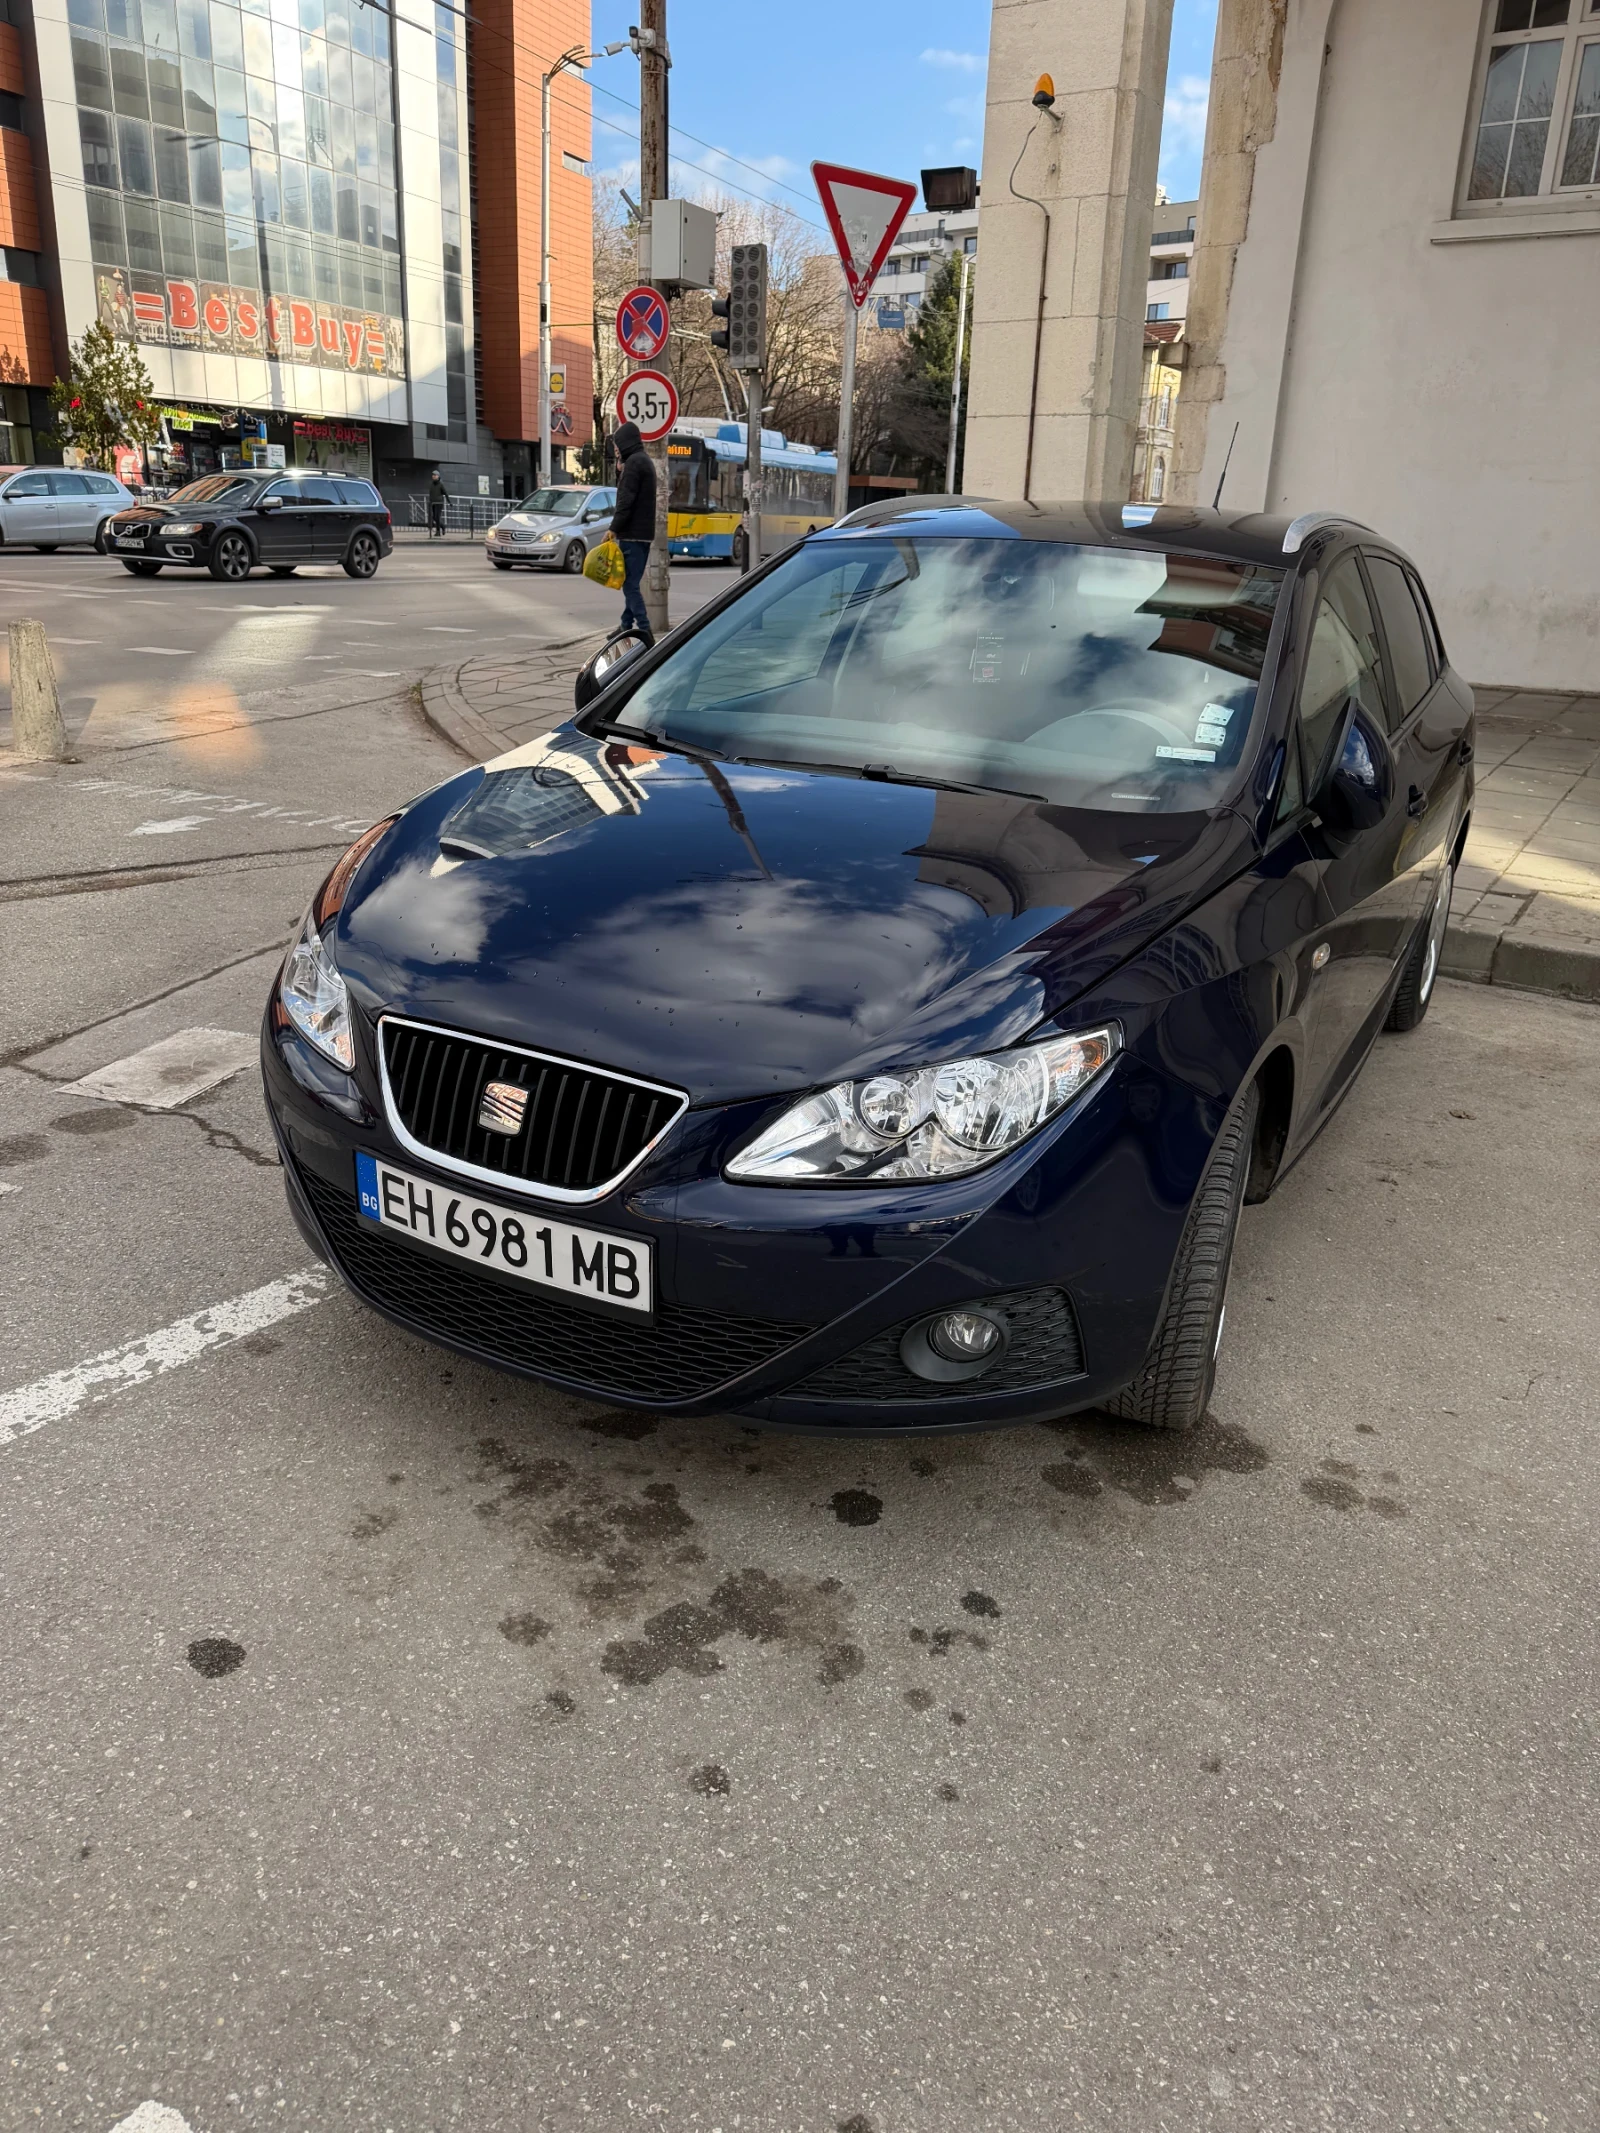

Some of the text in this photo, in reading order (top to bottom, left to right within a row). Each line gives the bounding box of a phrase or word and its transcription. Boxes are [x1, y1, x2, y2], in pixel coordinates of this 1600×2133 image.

[167, 281, 362, 368] Best Buy
[361, 1192, 378, 1211] BG
[381, 1170, 640, 1299] EH 6981 MB
